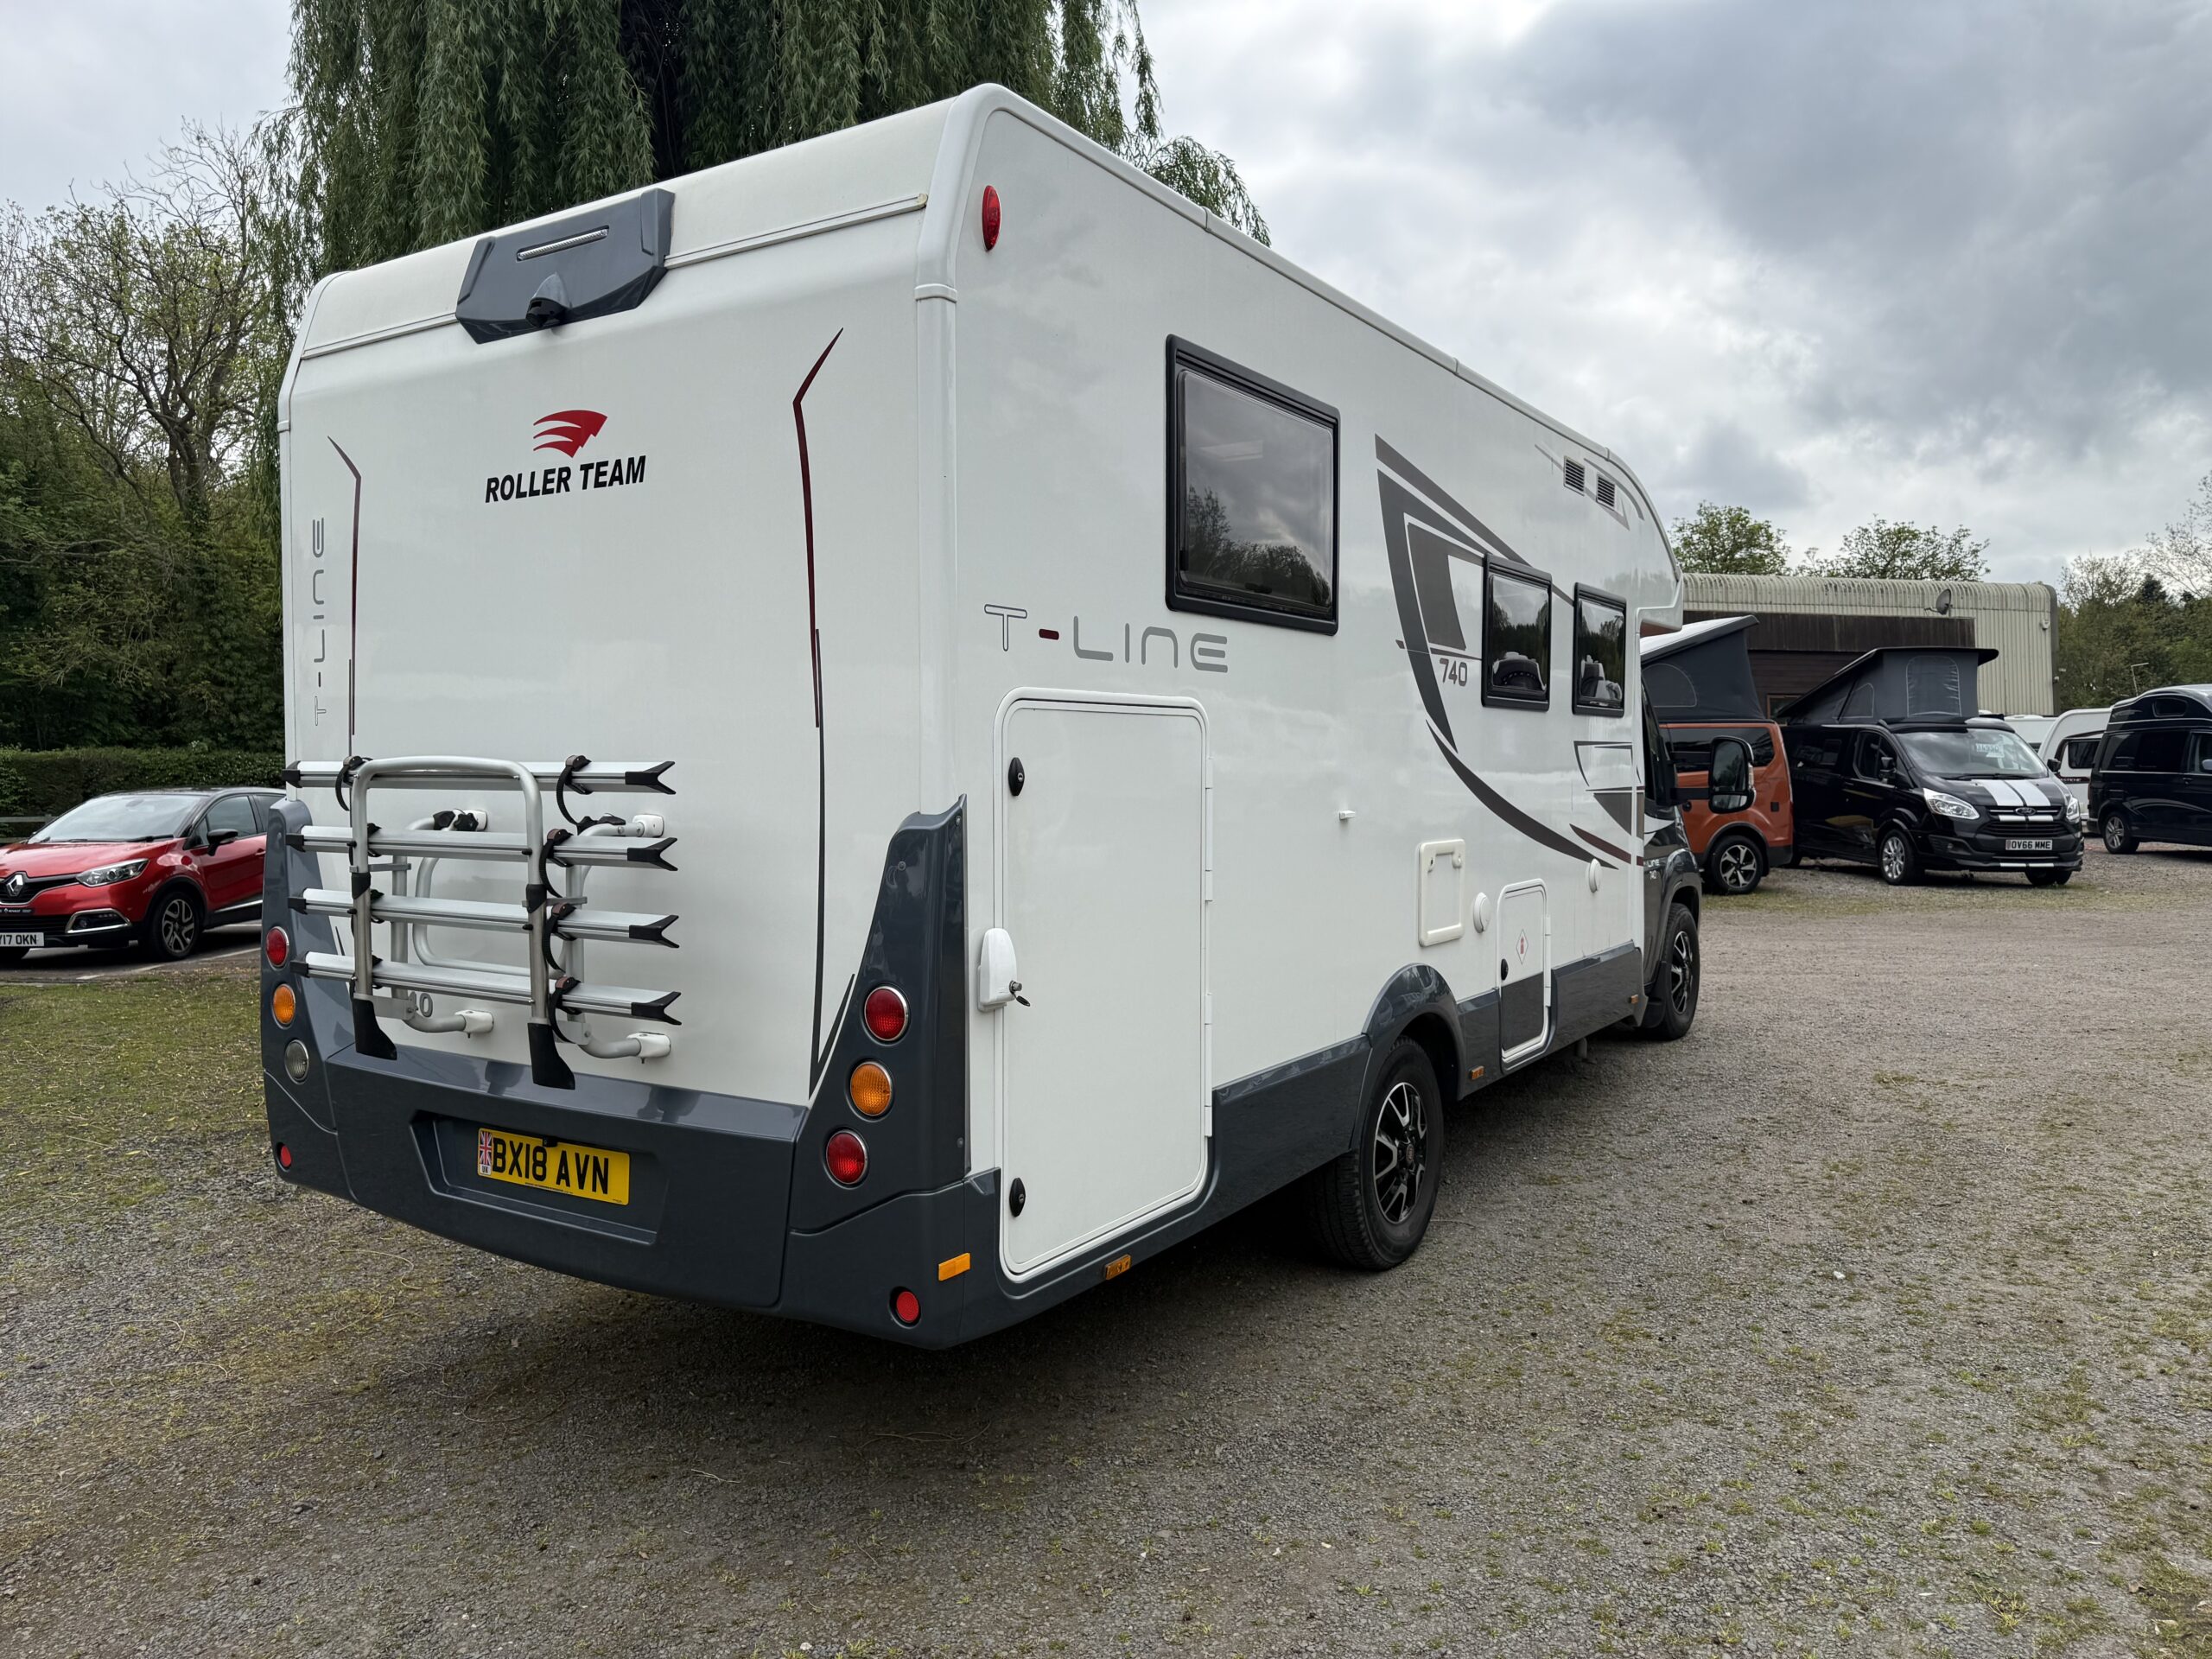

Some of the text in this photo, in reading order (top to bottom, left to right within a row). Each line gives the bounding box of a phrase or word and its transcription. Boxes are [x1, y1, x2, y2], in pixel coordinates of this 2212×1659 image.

[485, 454, 646, 504] ROLLER TEAM
[312, 517, 327, 727] T-LINE
[983, 603, 1229, 674] T-LINE
[1439, 658, 1468, 687] 740
[2011, 840, 2051, 849] OY66 MME
[16, 934, 37, 945] OKN
[492, 1137, 609, 1195] BX18 AVN
